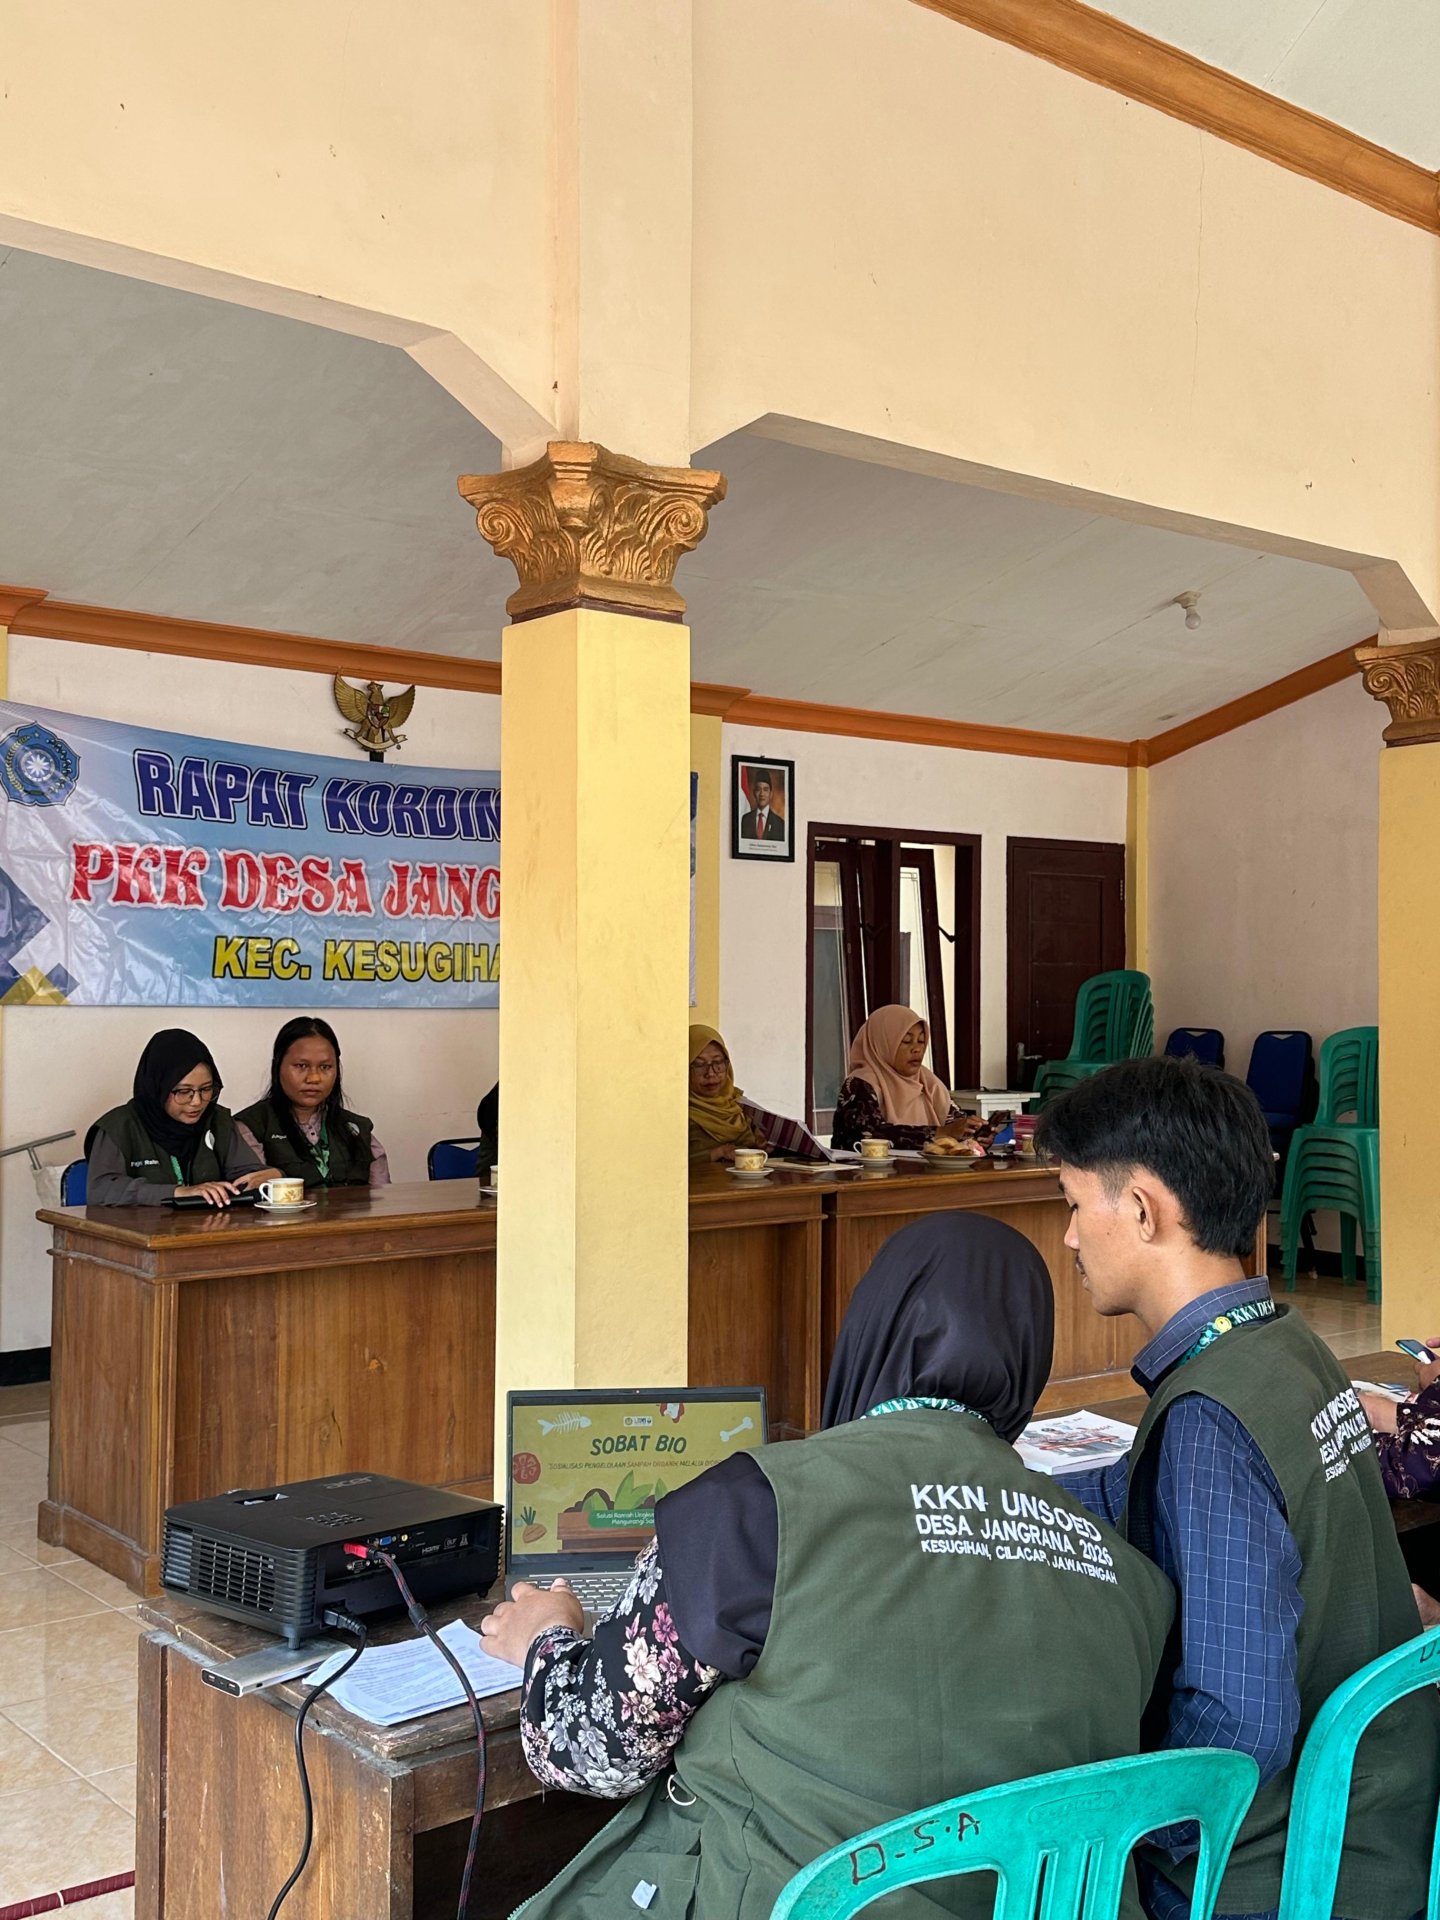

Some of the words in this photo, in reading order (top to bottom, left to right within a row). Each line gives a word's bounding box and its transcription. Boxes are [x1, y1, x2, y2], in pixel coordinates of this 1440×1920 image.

[134, 750, 315, 828] RAPAT
[323, 777, 500, 842] KORDIN
[70, 841, 209, 909] PKK
[221, 848, 375, 919] DESA
[386, 859, 500, 920] JANG
[213, 936, 311, 979] KEC.
[590, 1435, 651, 1456] SOBAT
[655, 1434, 687, 1454] BIO
[911, 1484, 987, 1512] KKN
[1001, 1489, 1102, 1542] UNSOED
[916, 1515, 973, 1536] DESA
[980, 1518, 1077, 1555] JANGRANA
[1079, 1539, 1113, 1567] 2026
[921, 1541, 992, 1560] KESUGIHAN,
